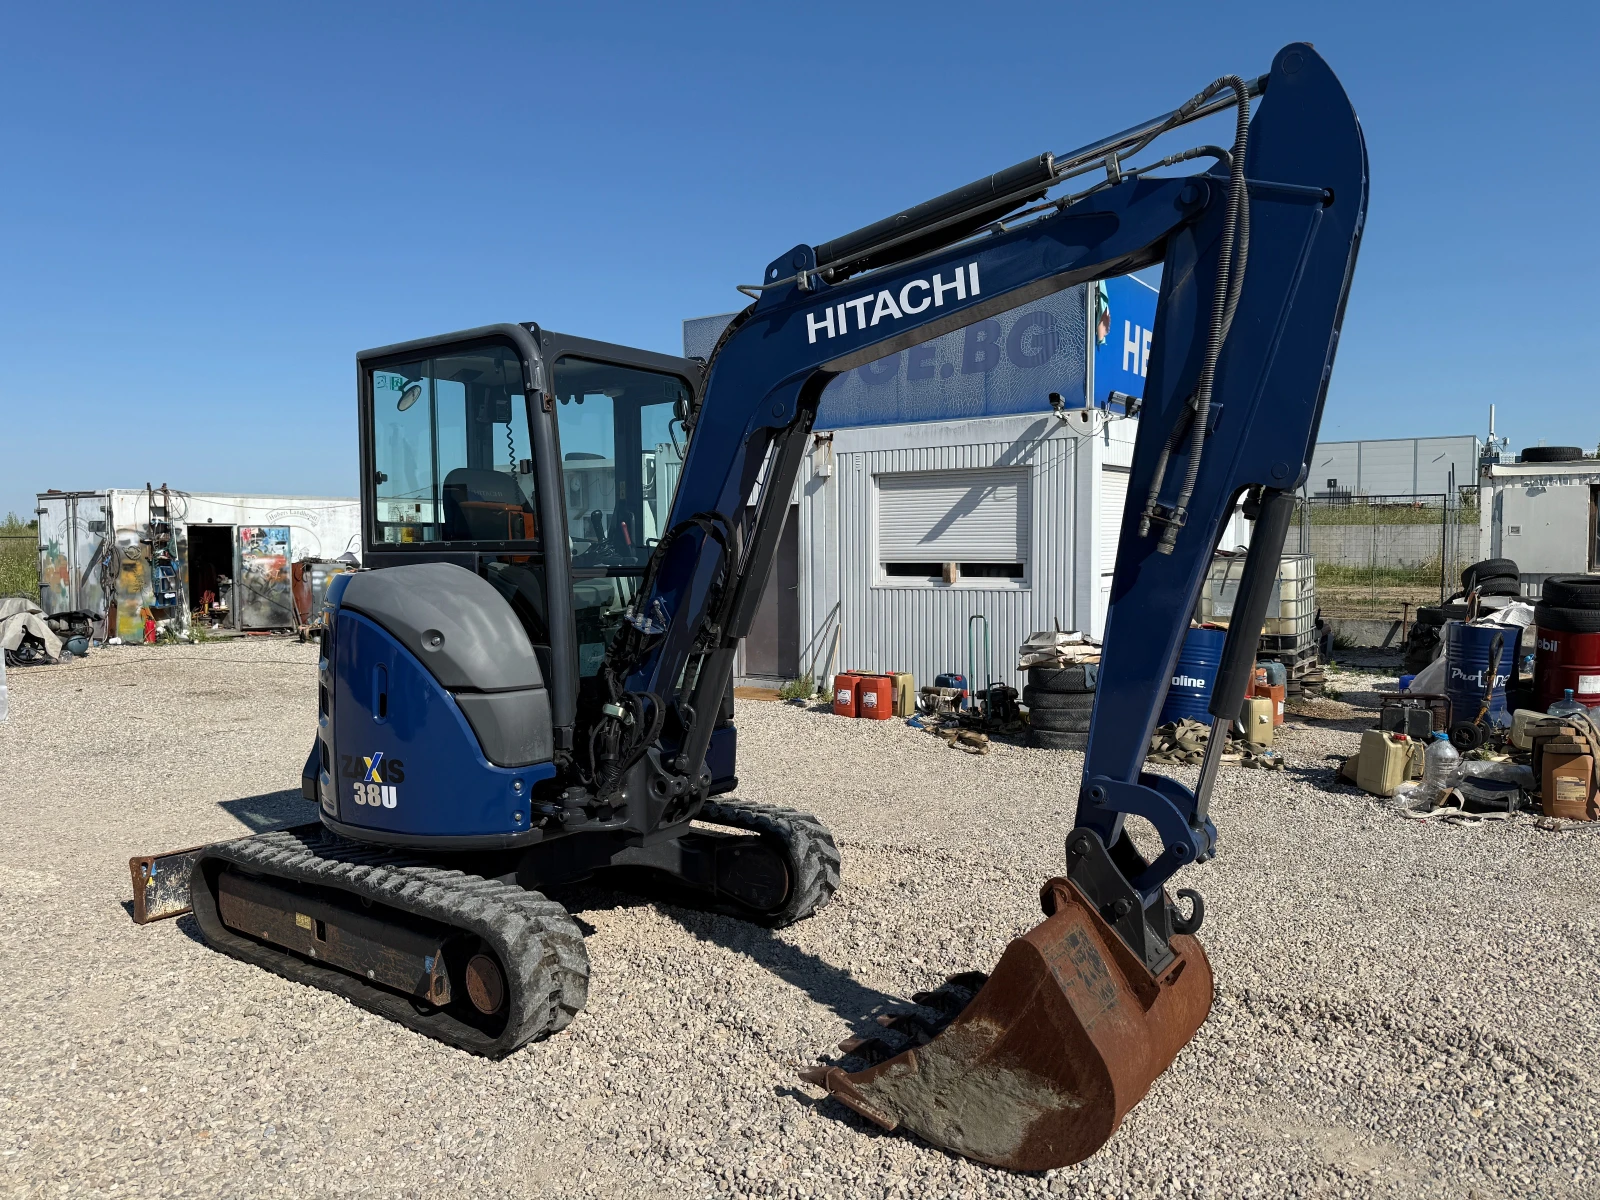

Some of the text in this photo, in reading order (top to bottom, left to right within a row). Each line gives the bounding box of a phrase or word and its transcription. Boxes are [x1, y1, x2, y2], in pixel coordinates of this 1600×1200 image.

[806, 262, 981, 344] HITACHI
[827, 311, 1060, 391] GE.BG
[341, 752, 405, 783] ZAXIS
[353, 782, 397, 809] 38U
